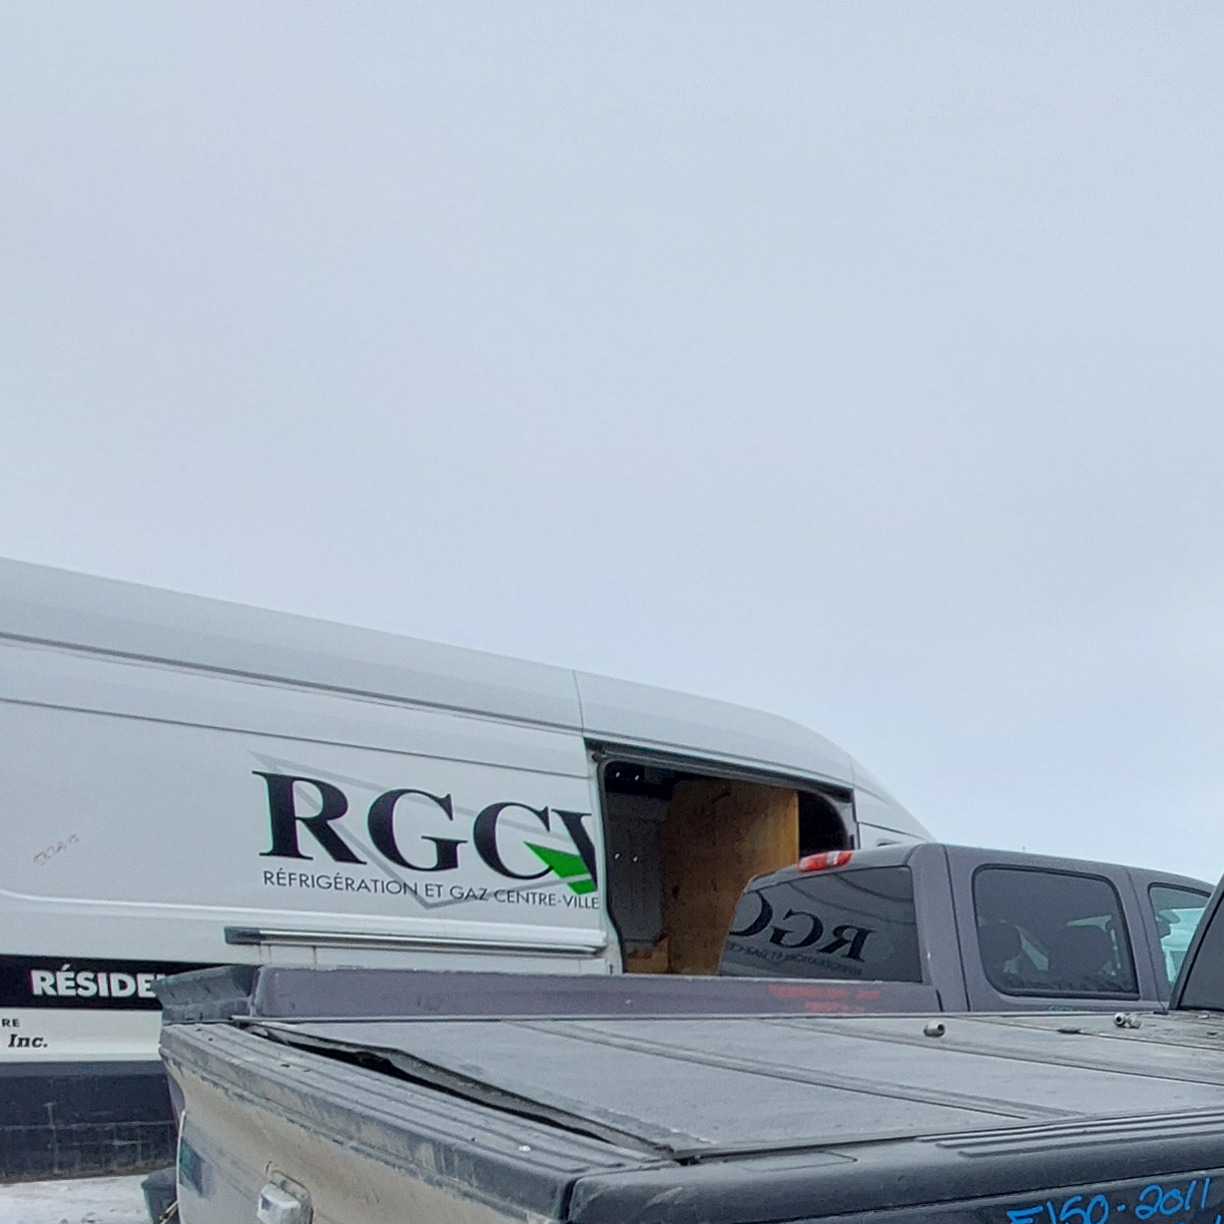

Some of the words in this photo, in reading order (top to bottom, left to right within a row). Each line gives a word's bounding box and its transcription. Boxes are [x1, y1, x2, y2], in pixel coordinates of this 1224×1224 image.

[263, 867, 419, 896] RÉFRIGÉRATION
[424, 883, 444, 898] ET
[449, 885, 489, 901] GAZ
[493, 889, 600, 910] CENTRE-VILLE
[30, 964, 166, 998] RÉSIDE
[8, 1034, 48, 1049] Inc.
